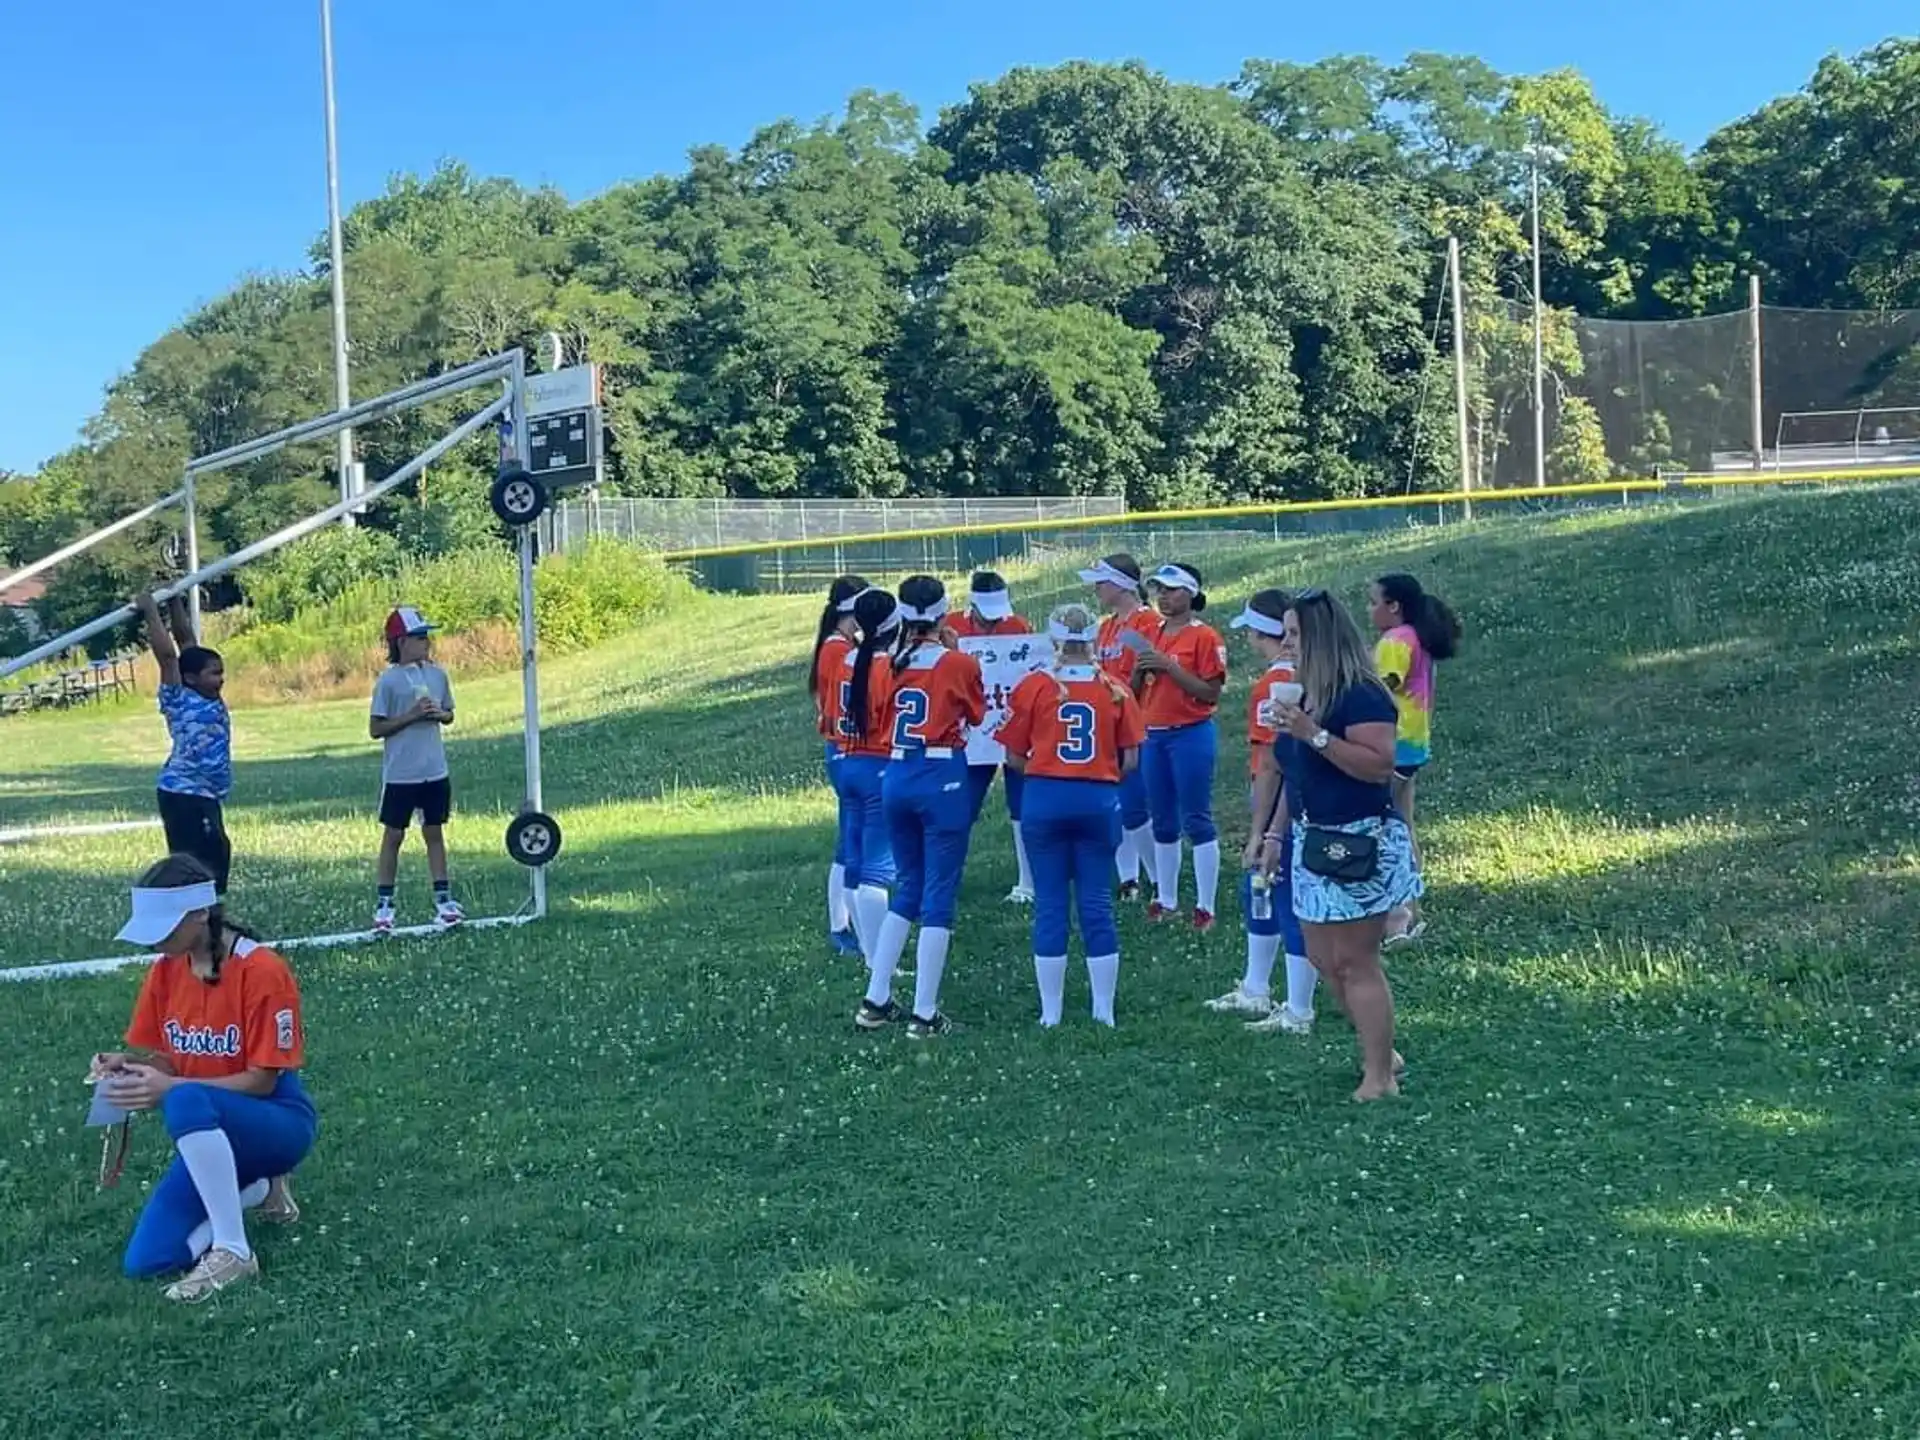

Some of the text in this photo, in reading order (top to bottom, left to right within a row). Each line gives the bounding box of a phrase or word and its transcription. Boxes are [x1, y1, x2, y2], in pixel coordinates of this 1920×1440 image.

[1009, 643, 1030, 661] of
[892, 687, 929, 750] 2
[1057, 702, 1095, 764] 3
[164, 1019, 241, 1057] Bristol
